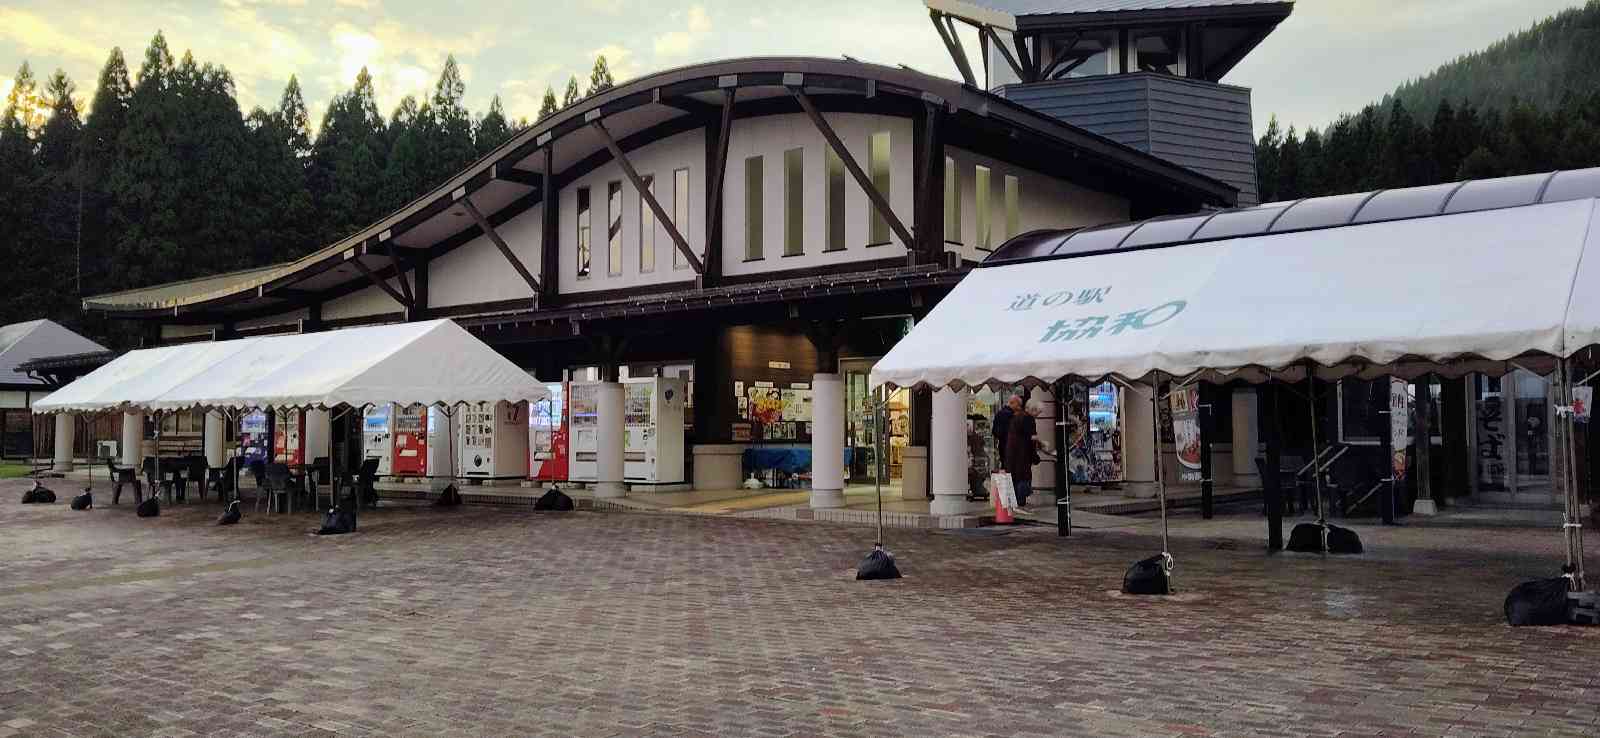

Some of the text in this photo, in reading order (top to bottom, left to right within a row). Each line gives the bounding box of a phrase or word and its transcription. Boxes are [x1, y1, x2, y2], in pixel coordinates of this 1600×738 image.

[1006, 285, 1112, 312] 道の駅
[1039, 300, 1187, 344] 協和
